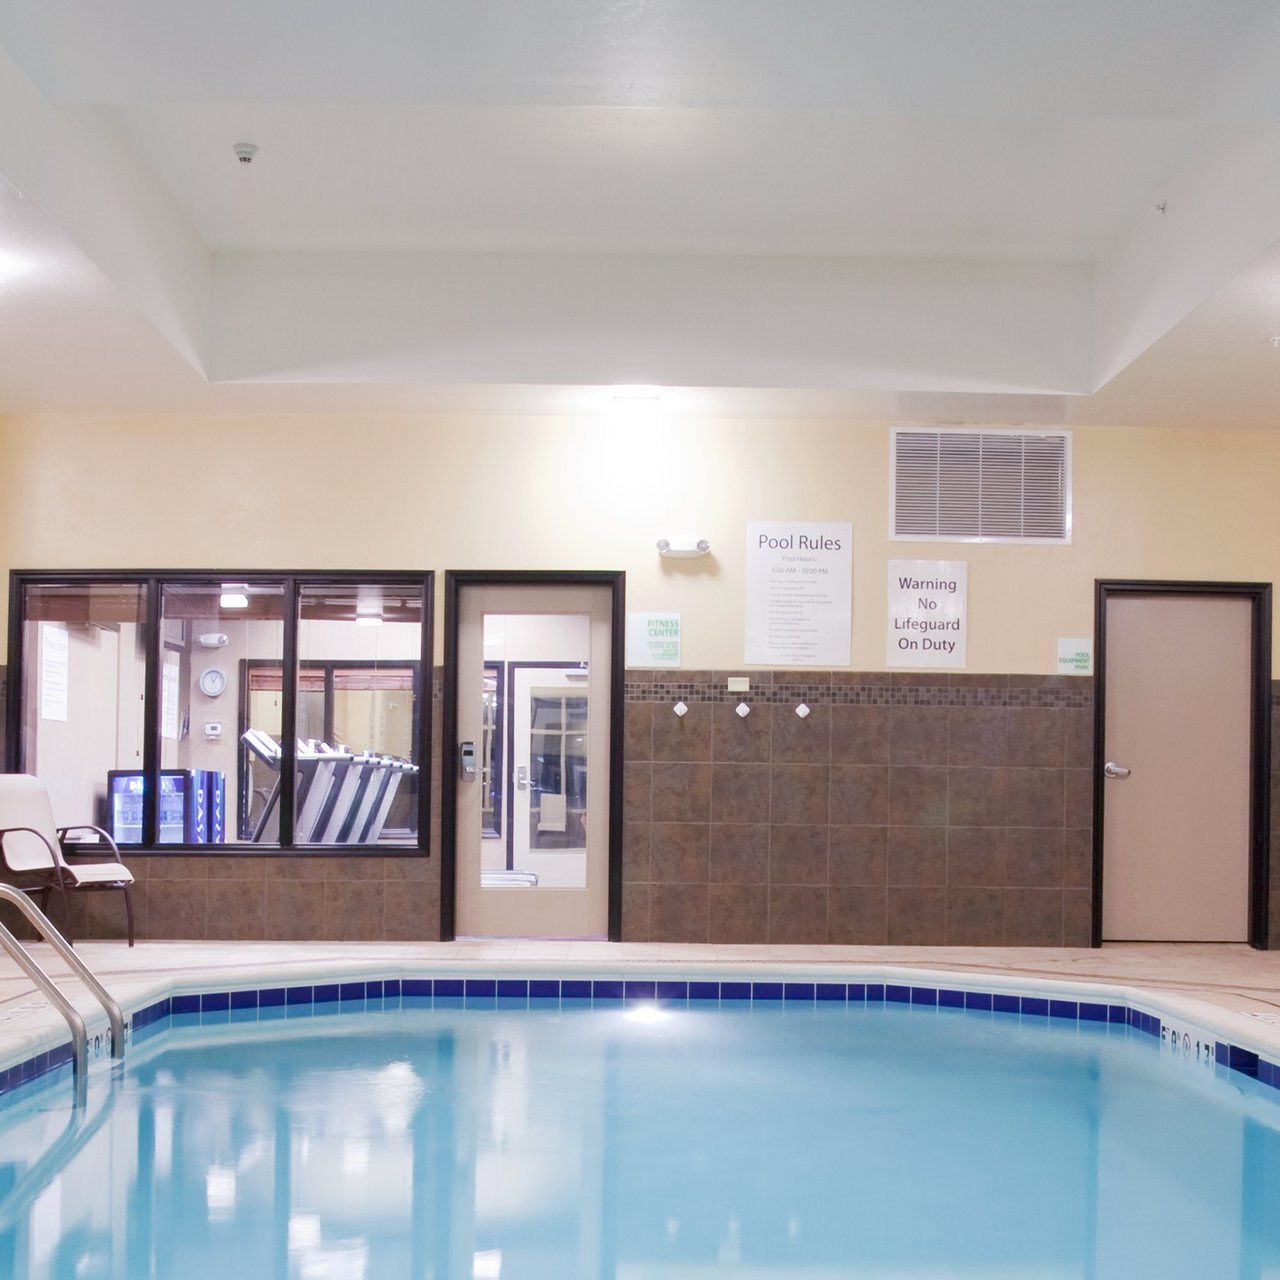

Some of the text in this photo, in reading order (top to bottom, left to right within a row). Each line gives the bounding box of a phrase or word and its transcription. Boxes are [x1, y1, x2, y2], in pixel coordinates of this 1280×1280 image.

[759, 534, 841, 550] Pool Rules
[898, 577, 957, 593] Warning
[918, 597, 937, 610] No
[647, 619, 679, 628] FITNESS
[894, 617, 960, 633] Lifeguard
[648, 628, 679, 637] CENTER
[898, 637, 956, 654] On Duty
